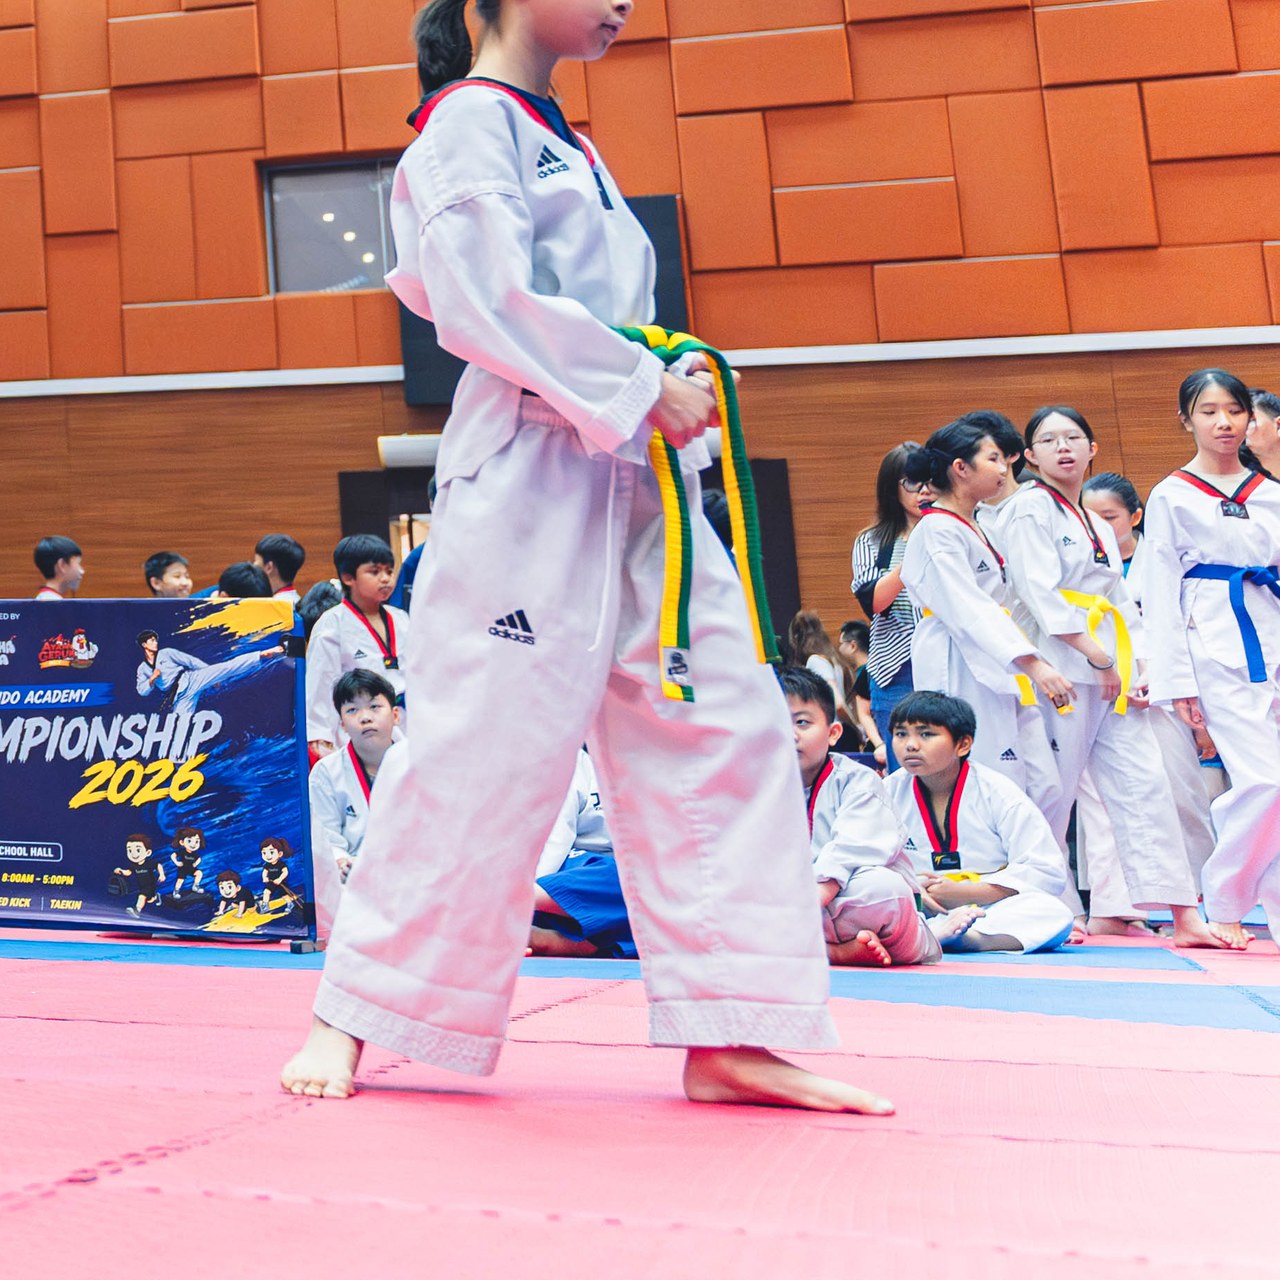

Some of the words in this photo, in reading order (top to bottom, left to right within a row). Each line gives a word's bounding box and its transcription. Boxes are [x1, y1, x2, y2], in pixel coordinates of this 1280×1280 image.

[10, 612, 21, 620] BY
[488, 626, 535, 646] adidas
[24, 688, 90, 704] ACADEMY
[68, 752, 211, 809] 2026
[30, 846, 54, 858] HALL
[1, 872, 34, 884] 8:00AM
[42, 874, 74, 886] 5:00PM
[9, 896, 32, 908] KICK
[50, 898, 83, 910] TAEKIN
